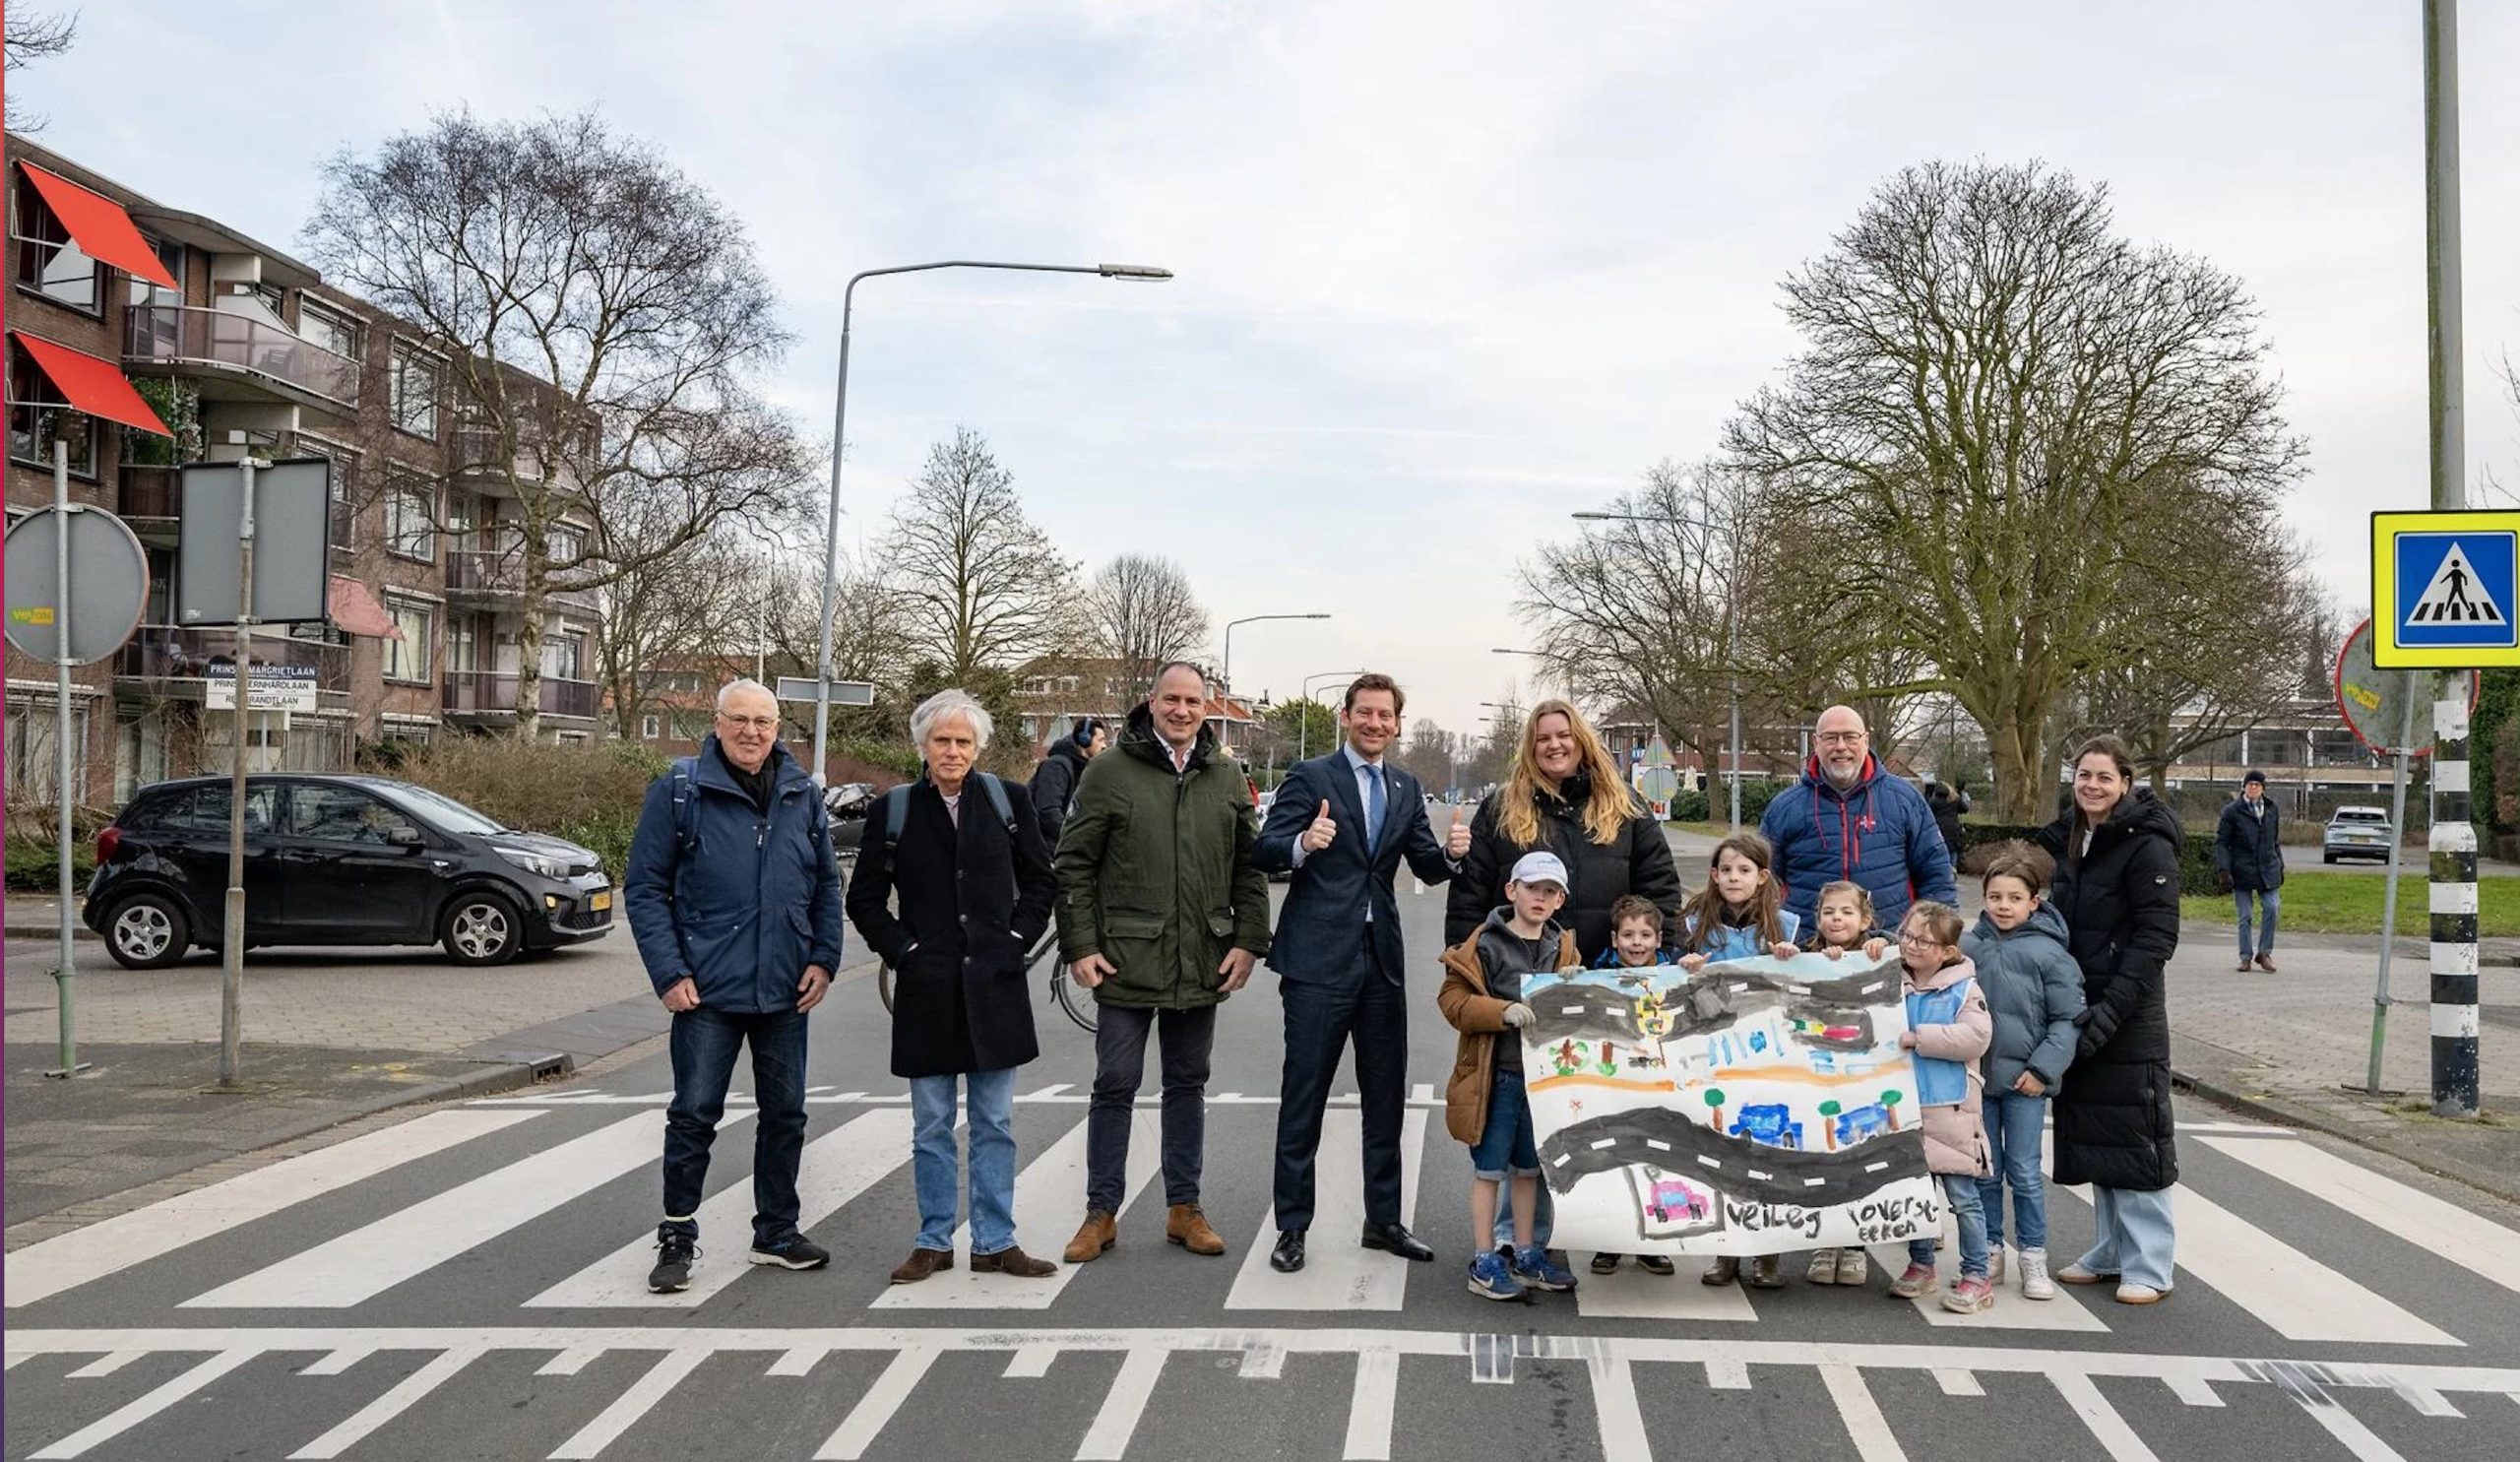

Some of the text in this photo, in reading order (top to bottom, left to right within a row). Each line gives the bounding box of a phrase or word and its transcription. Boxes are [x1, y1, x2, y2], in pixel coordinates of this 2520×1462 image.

[210, 664, 315, 676] PRINS MARGRIETLAAN
[247, 679, 309, 690] ERNHARDLAAN
